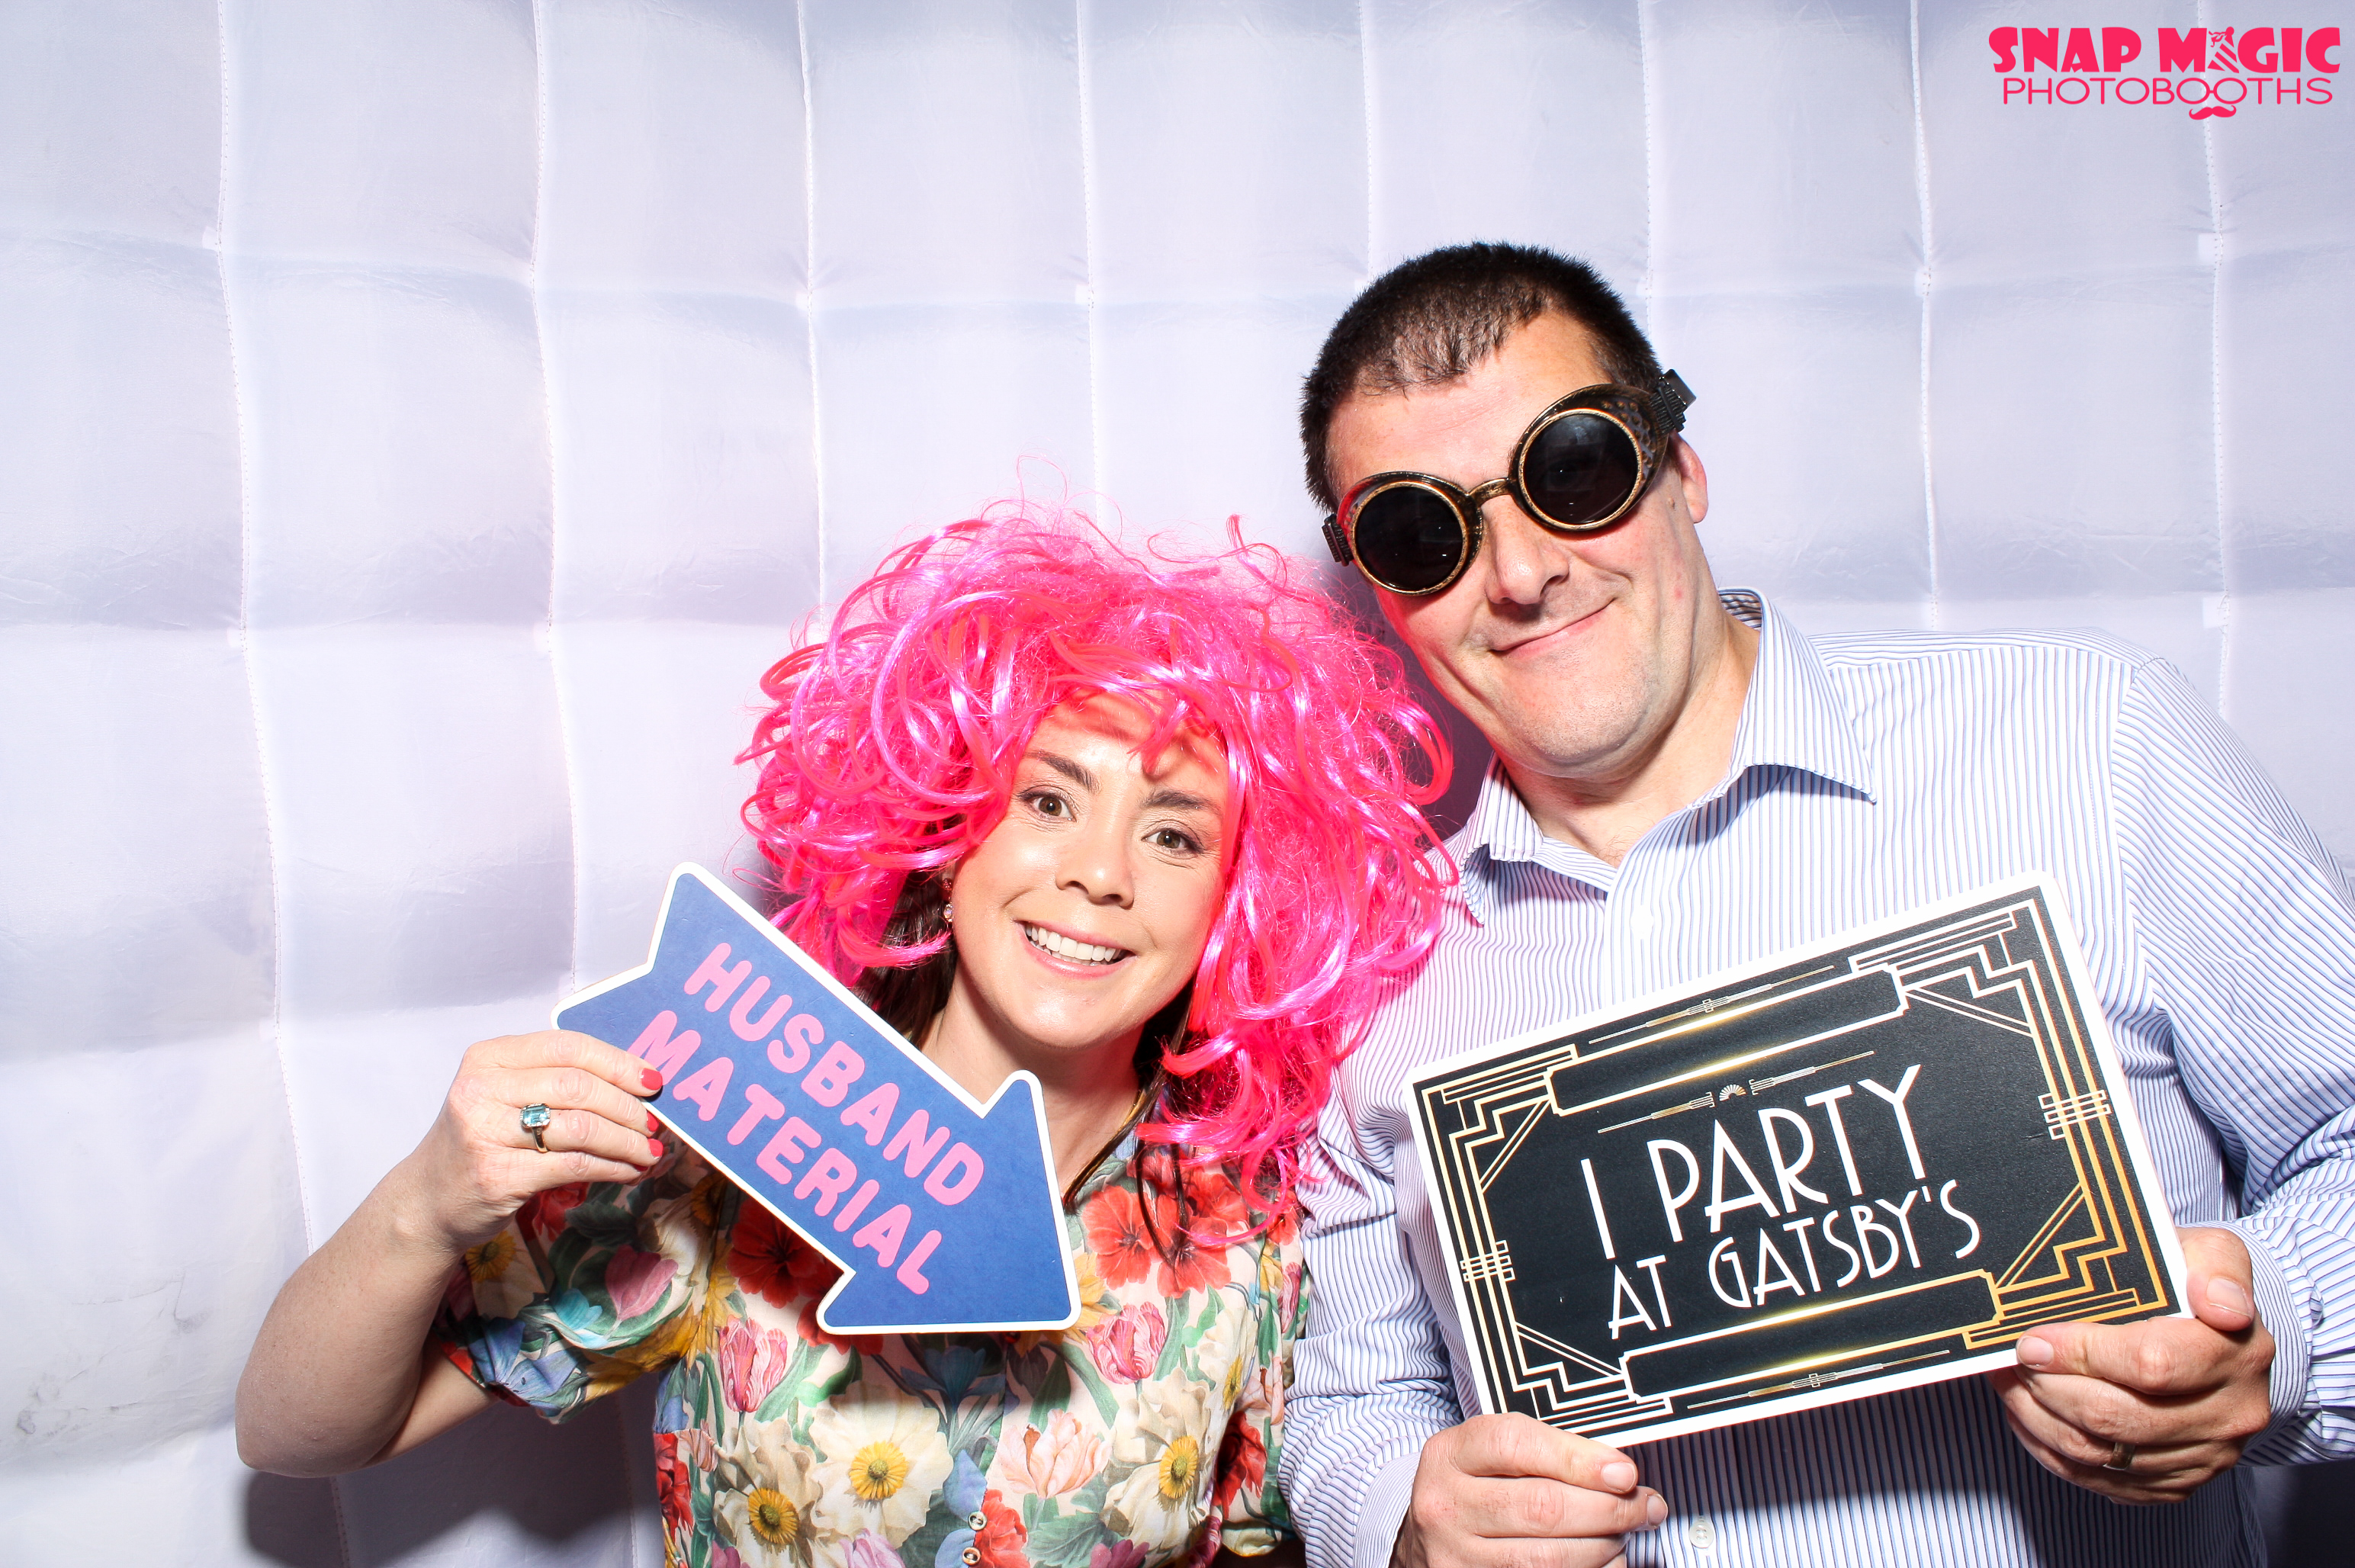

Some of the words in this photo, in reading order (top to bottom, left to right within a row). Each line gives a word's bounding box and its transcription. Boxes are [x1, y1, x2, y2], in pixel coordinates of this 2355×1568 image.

[625, 1010, 943, 1295] MATERIAL
[683, 942, 985, 1206] HUSBAND
[1580, 1158, 1616, 1260] I
[1647, 1063, 1926, 1243] PARTY
[1608, 1255, 1672, 1340] AT
[1708, 1179, 1981, 1309] GATSBY'S
